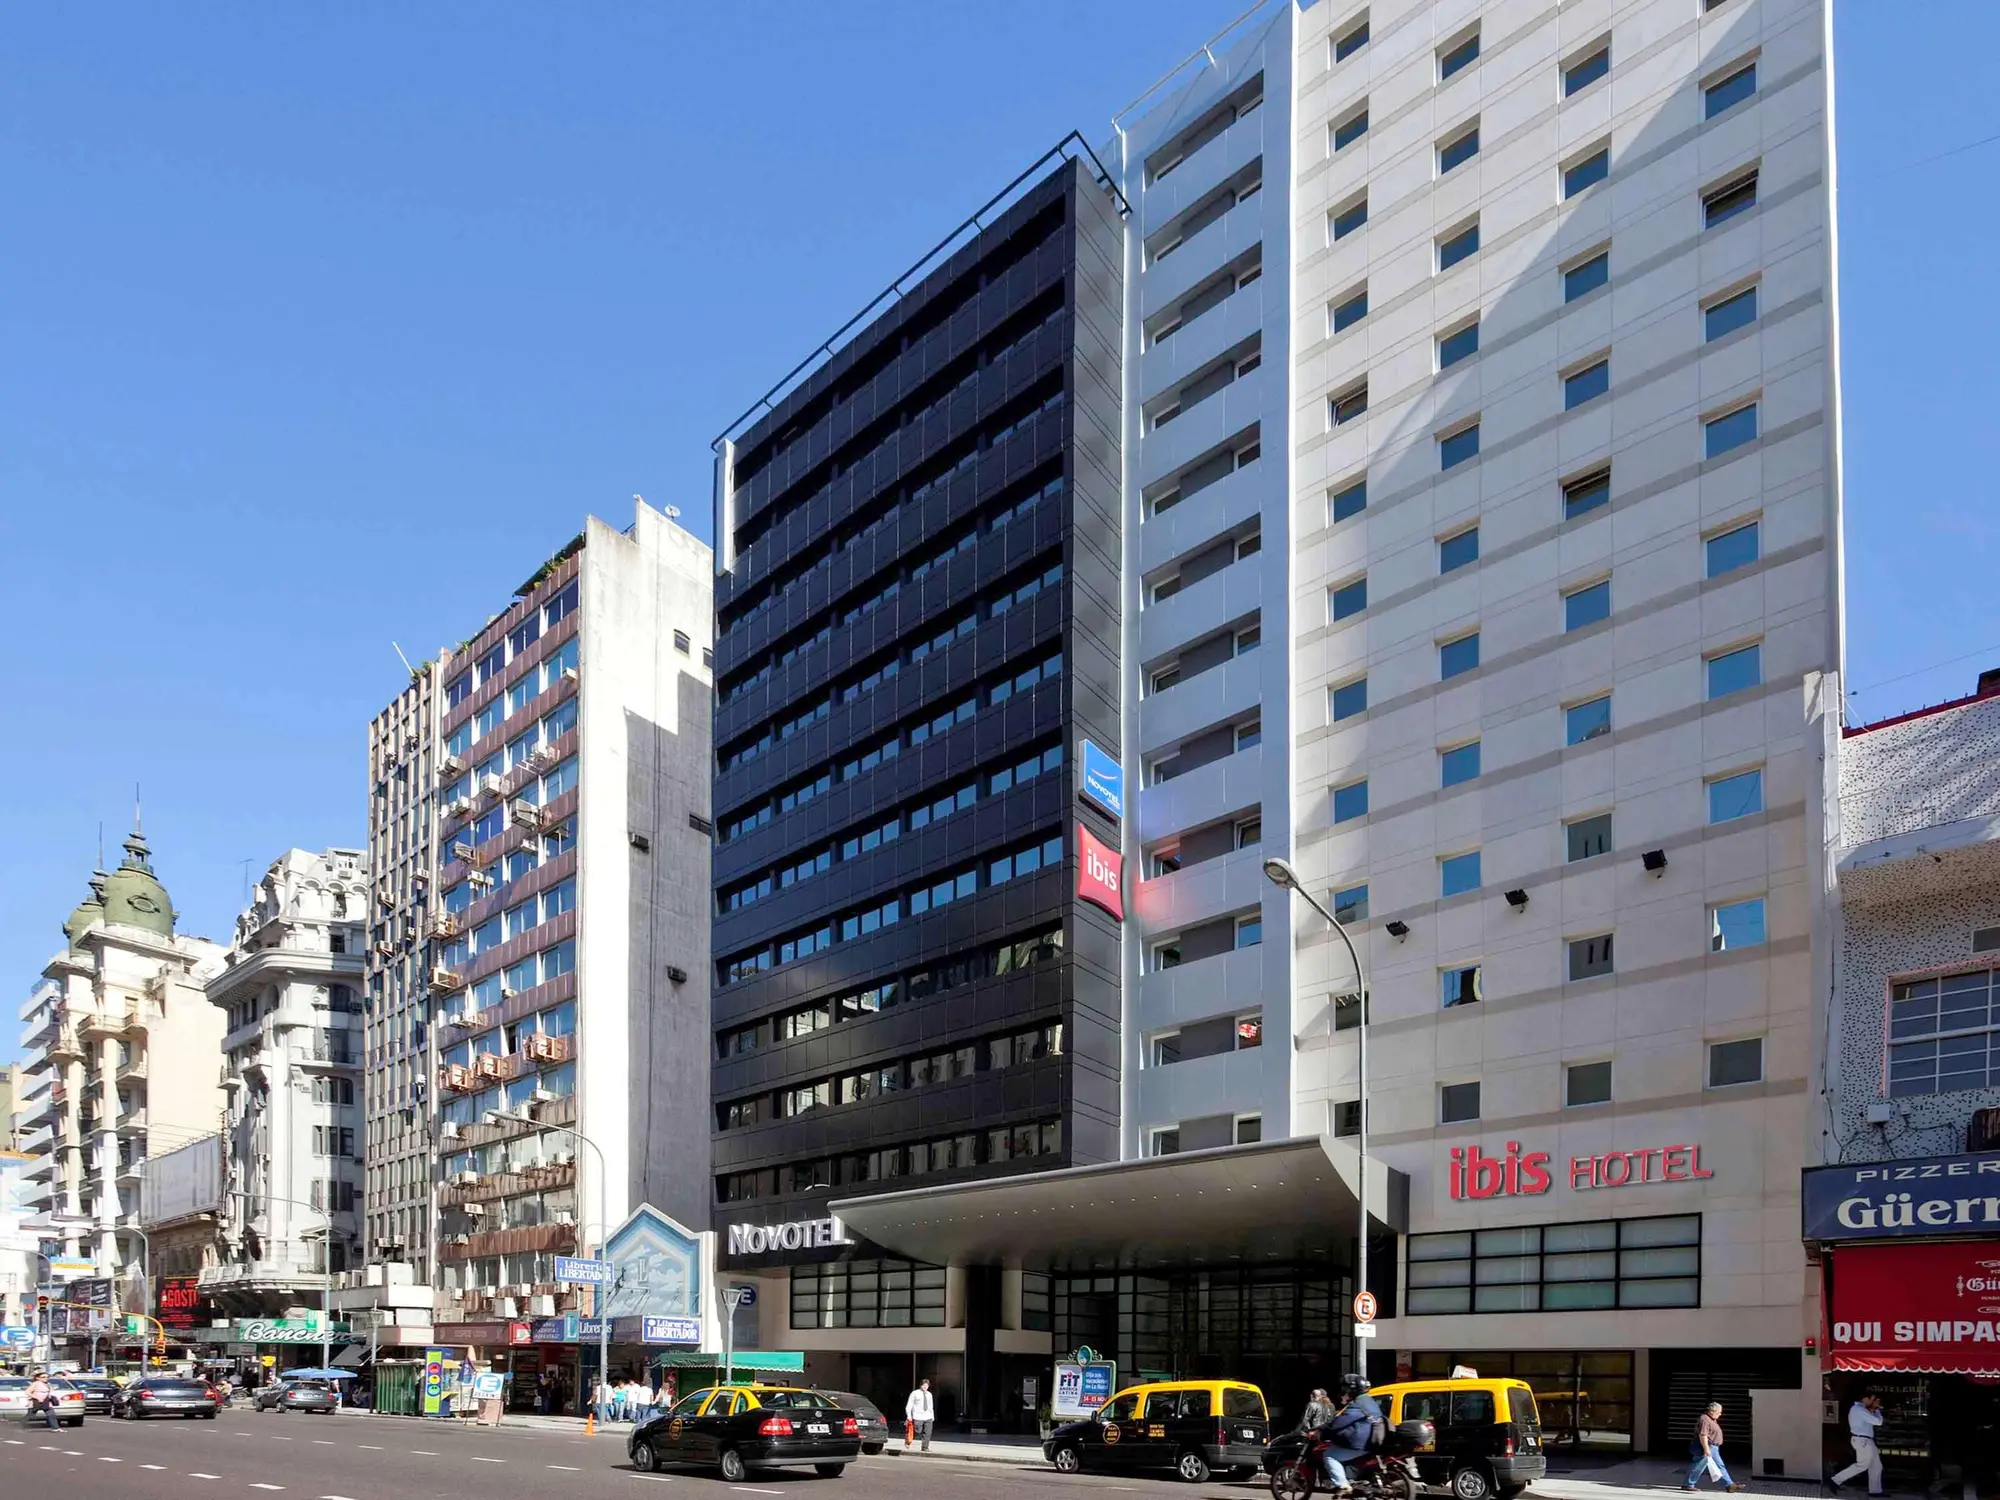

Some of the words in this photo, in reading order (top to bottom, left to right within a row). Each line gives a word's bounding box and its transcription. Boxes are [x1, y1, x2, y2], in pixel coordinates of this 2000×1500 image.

[1088, 775, 1118, 803] NOVOTEL
[1087, 848, 1117, 891] ibis
[1450, 1141, 1551, 1199] ibis
[1569, 1145, 1713, 1189] HOTEL
[1856, 1161, 2000, 1182] PIZZER
[728, 1212, 855, 1255] NOVOTEL
[1966, 1277, 2000, 1292] Gü
[740, 1288, 752, 1303] E
[647, 1326, 698, 1339] LIBERTADOR
[1834, 1322, 1881, 1343] QUI
